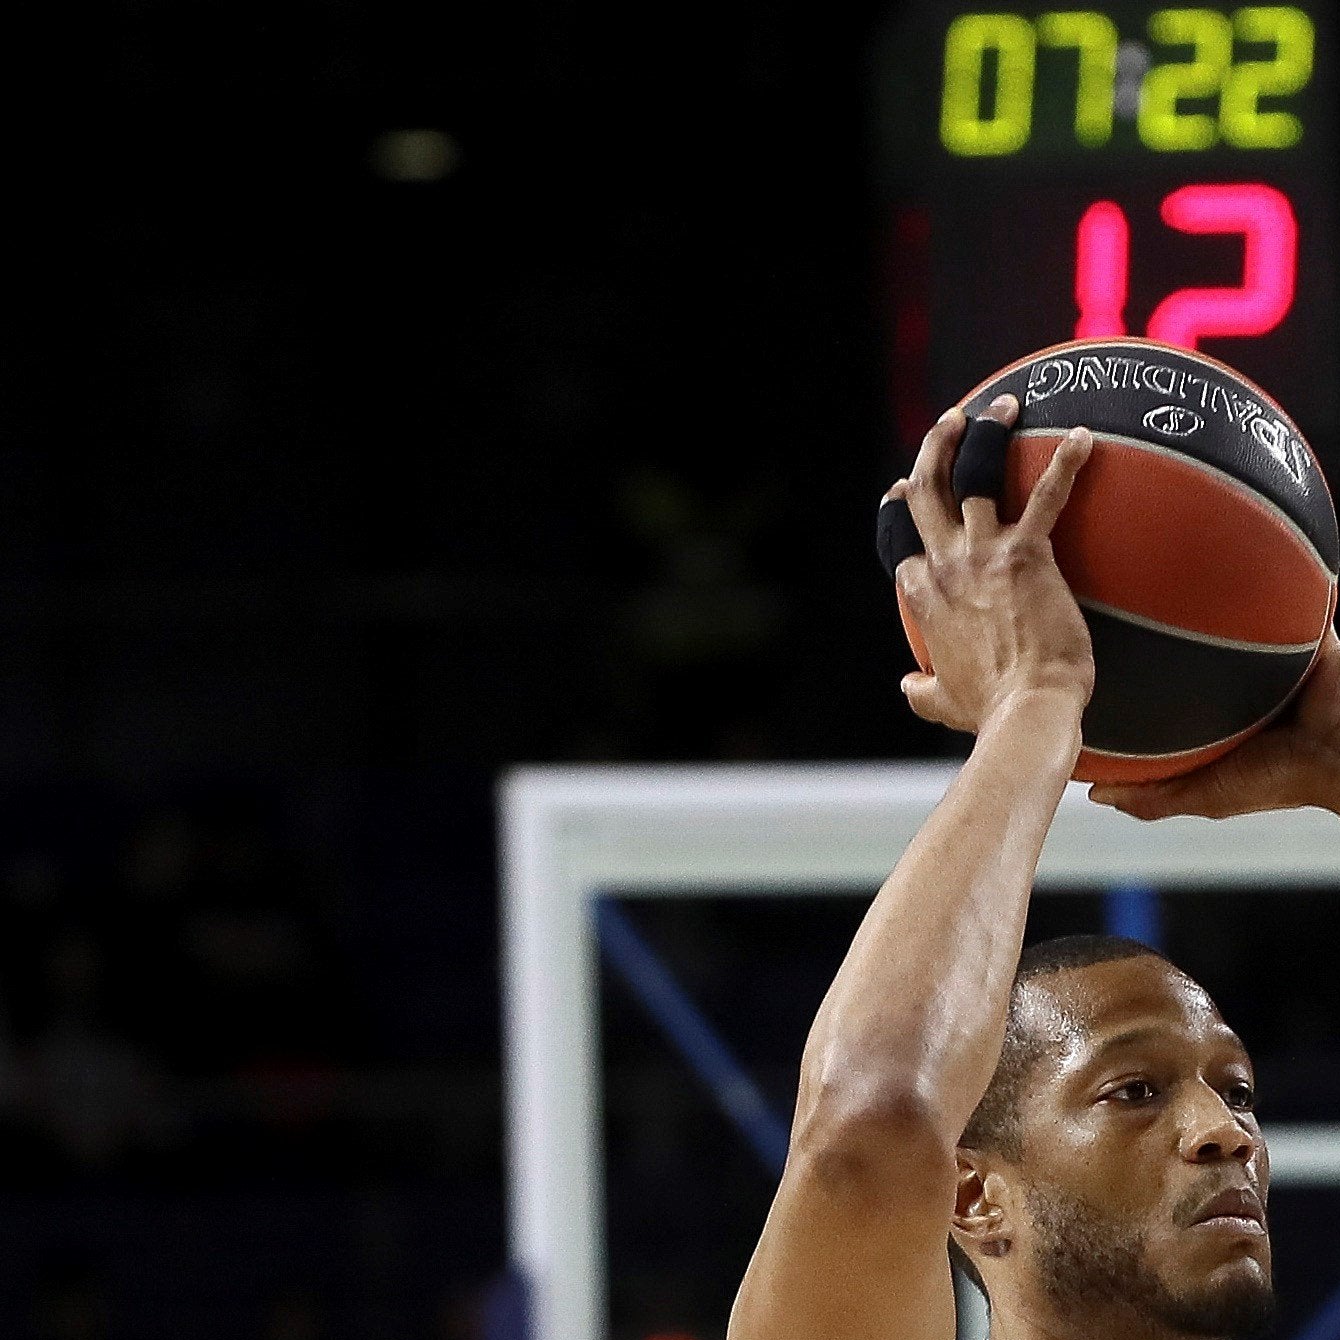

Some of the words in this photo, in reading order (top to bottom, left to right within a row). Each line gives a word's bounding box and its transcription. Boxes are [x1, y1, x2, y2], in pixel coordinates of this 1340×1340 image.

[940, 6, 1315, 158] 07:22
[1075, 182, 1297, 349] 12
[1025, 356, 1311, 496] SPALDING
